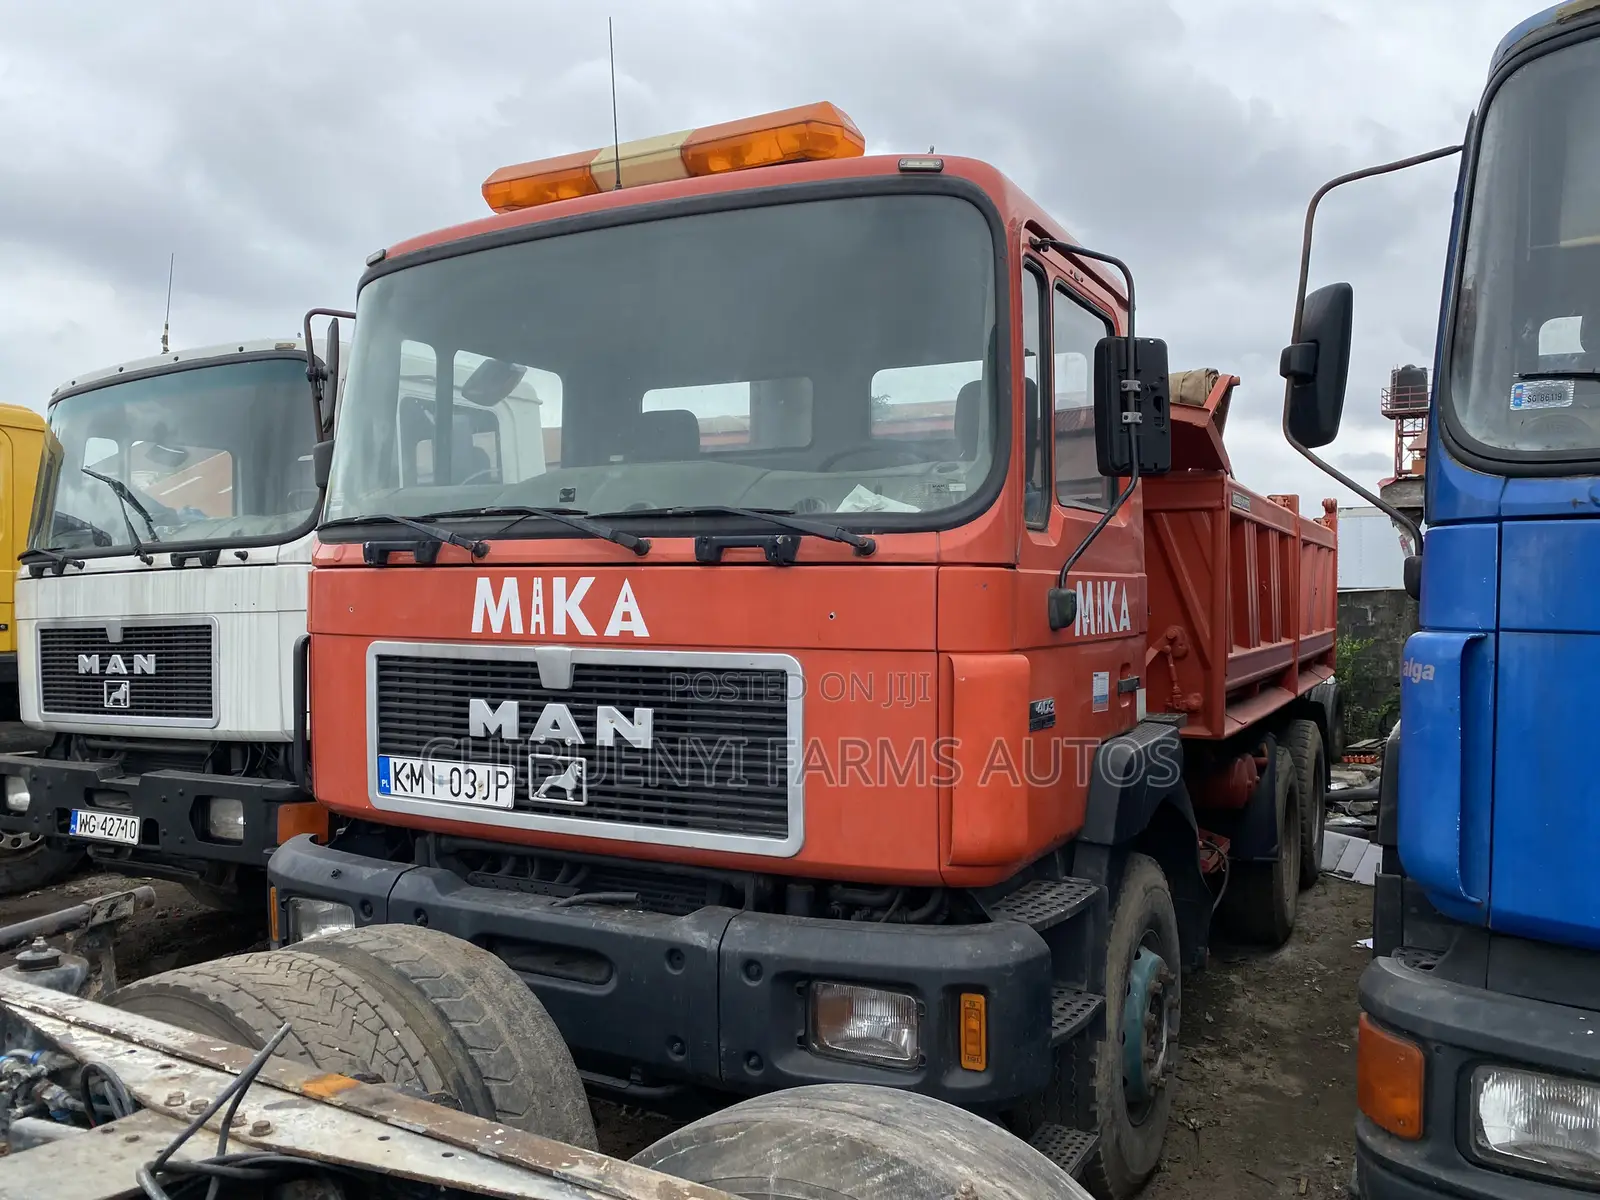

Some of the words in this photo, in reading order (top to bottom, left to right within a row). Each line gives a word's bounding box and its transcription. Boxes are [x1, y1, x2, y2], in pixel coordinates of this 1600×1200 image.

[471, 576, 650, 637] MIKA
[1075, 581, 1131, 636] MIKA
[77, 653, 157, 675] MAN
[469, 699, 654, 749] MAN
[381, 779, 390, 788] PL
[393, 761, 436, 795] KMI
[449, 766, 509, 802] 03JP
[79, 813, 97, 833] WG
[100, 816, 137, 839] 42710
